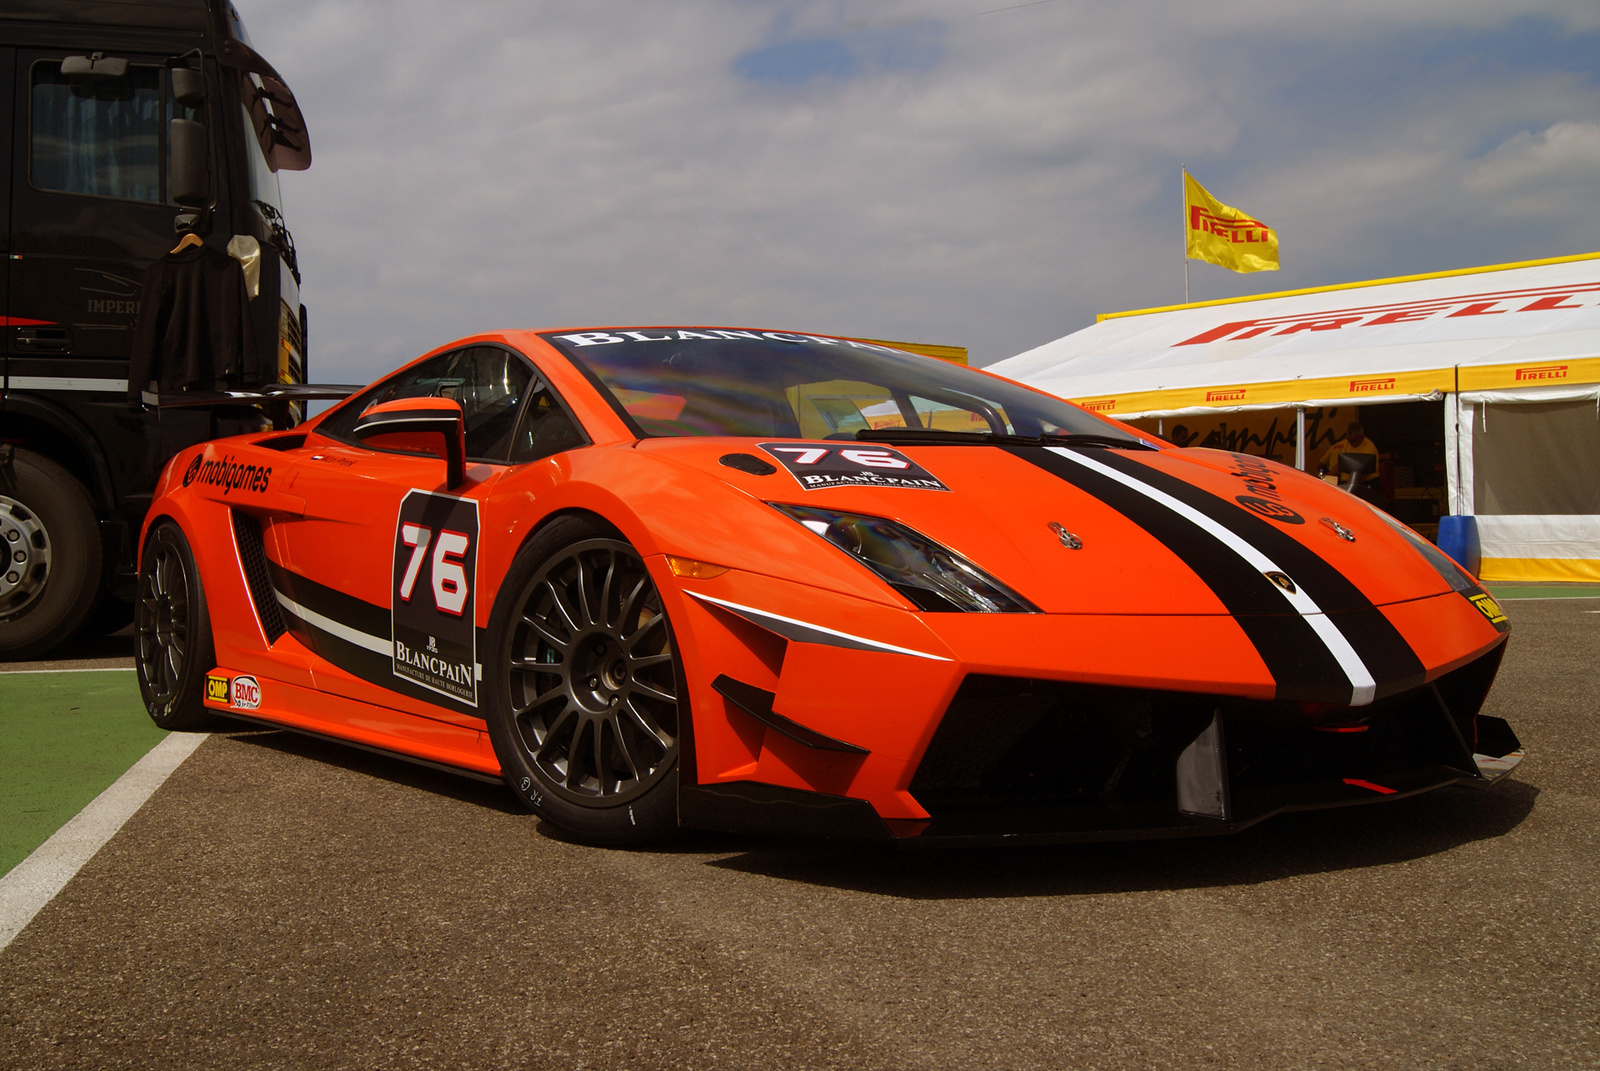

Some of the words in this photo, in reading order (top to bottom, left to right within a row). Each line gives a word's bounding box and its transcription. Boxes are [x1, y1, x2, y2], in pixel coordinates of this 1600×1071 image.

[1191, 205, 1268, 243] PIRELLI
[1170, 282, 1600, 348] PIRELL
[1515, 365, 1568, 381] PIRELLI
[1206, 389, 1246, 402] PIRELLI
[1350, 378, 1395, 392] PIRELLI
[1081, 399, 1116, 411] PRELLI
[772, 447, 911, 470] 76
[197, 454, 272, 496] mobigames
[802, 474, 942, 488] BLANCPAIN
[399, 521, 470, 616] 76
[395, 640, 472, 687] BLANCPAIN
[208, 680, 228, 698] OMP
[235, 682, 258, 704] BMC
